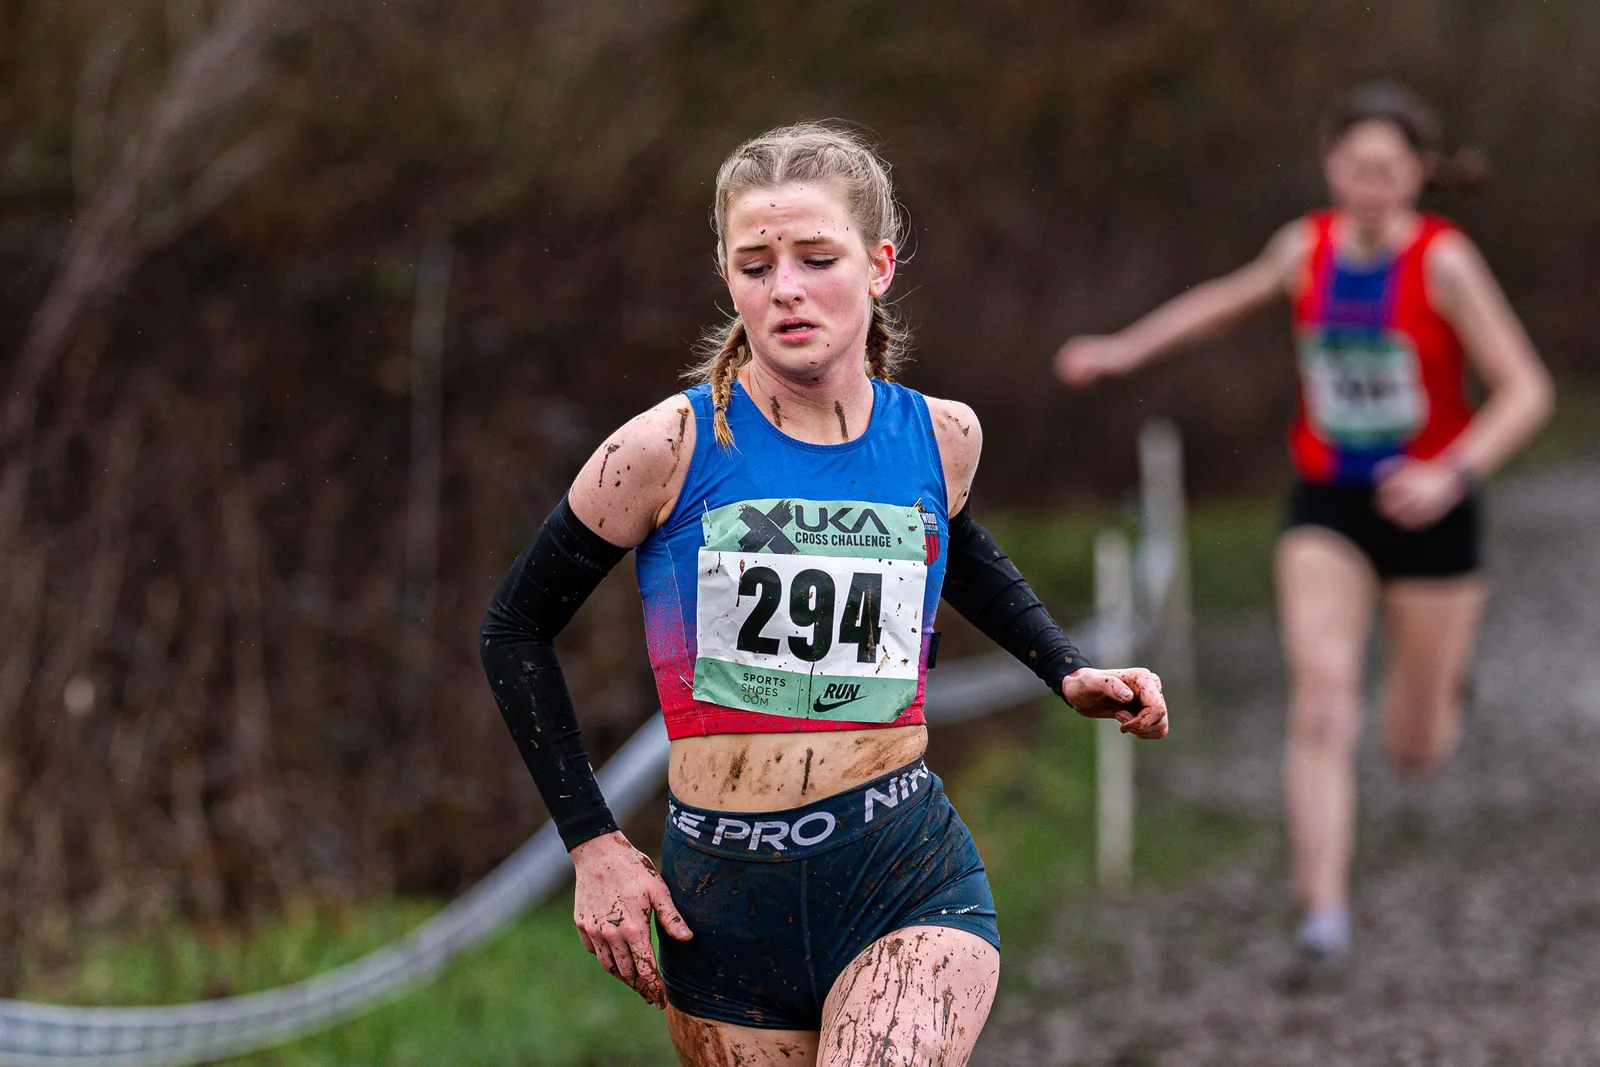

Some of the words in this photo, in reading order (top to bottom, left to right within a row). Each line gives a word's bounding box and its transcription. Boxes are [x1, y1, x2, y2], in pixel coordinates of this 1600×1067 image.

[795, 504, 890, 535] UKA
[795, 531, 829, 546] CROSS
[831, 533, 892, 548] CHALLENGE
[736, 566, 883, 664] 294
[743, 672, 786, 687] SPORTS
[741, 683, 778, 697] SHOES
[823, 683, 861, 700] RUN
[742, 694, 769, 707] COM
[711, 811, 836, 851] PRO
